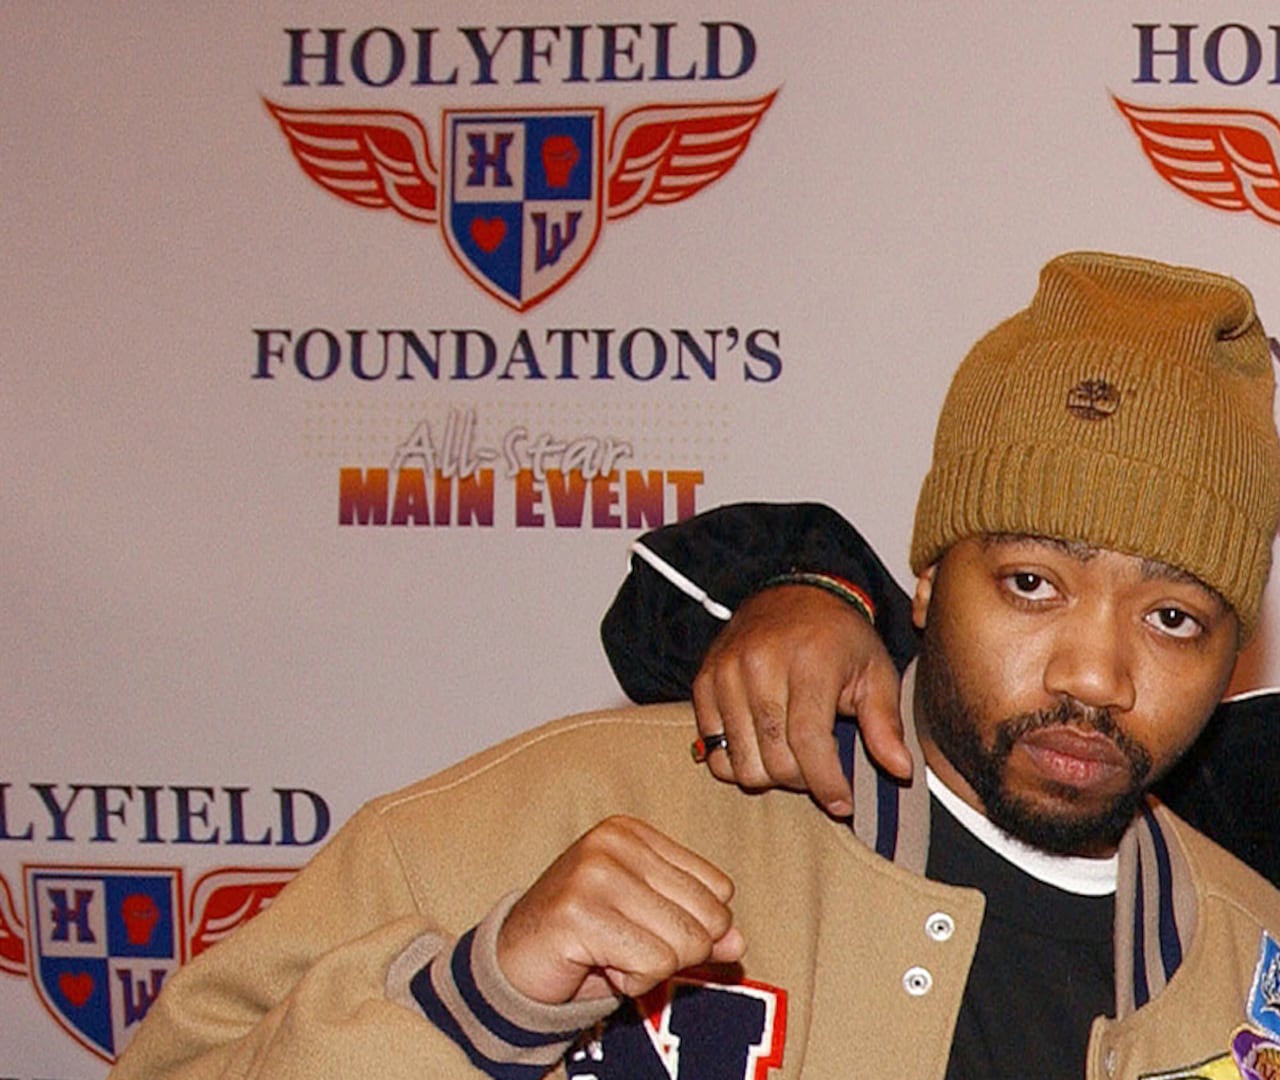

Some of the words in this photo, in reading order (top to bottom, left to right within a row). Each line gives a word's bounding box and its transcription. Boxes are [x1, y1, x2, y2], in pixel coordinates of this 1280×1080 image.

[281, 20, 758, 88] HOLYFIELD
[251, 327, 784, 383] FOUNDATION'S
[392, 407, 636, 482] All-Star
[338, 466, 495, 528] MAIN
[515, 468, 705, 529] EVENT
